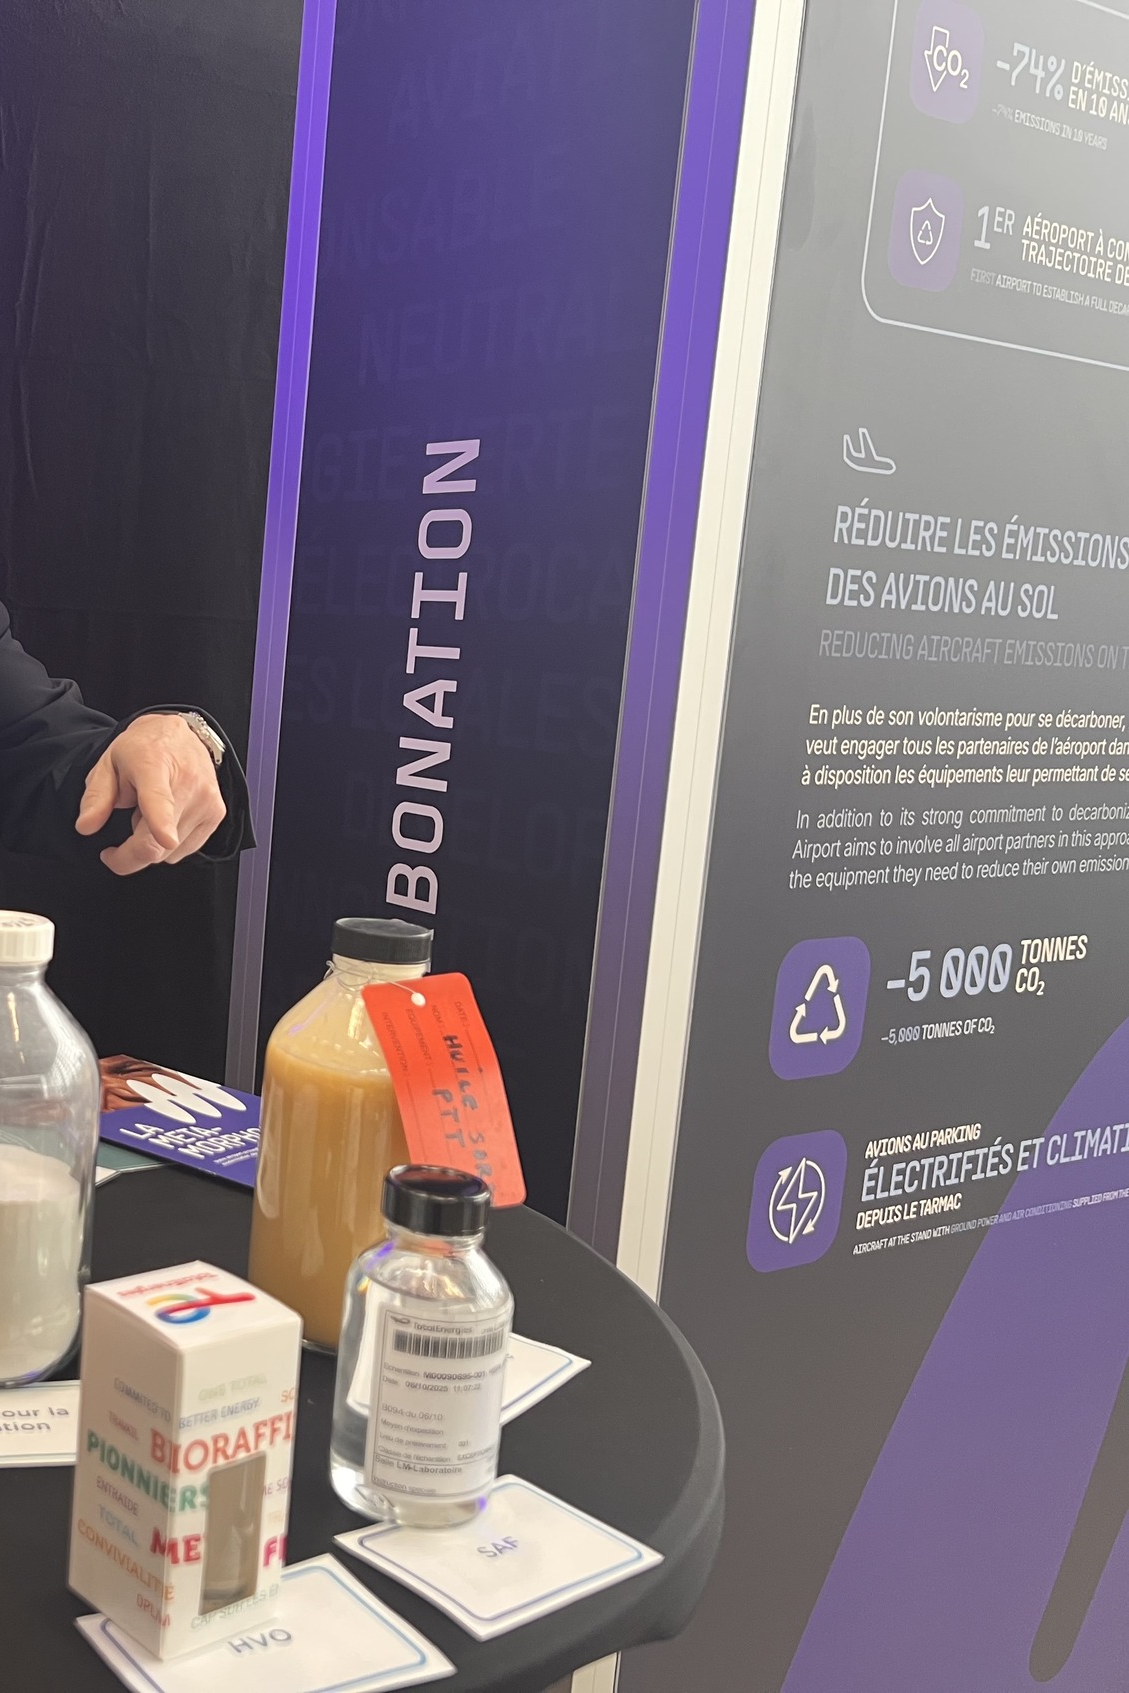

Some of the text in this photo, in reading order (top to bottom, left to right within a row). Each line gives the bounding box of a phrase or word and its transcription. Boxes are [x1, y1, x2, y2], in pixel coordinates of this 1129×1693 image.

[995, 41, 1066, 101] -74%
[1068, 85, 1129, 125] EN 10 AN
[1014, 109, 1061, 136] EMISSIONS
[1061, 123, 1072, 139] IN
[1083, 132, 1108, 151] YEARS
[1022, 212, 1104, 256] AÉROPORT À
[1021, 239, 1114, 282] TRAJECTOIRE
[971, 267, 1108, 312] FIRST AIRPORT TO ESTABLISH A FULL
[833, 497, 1129, 570] RÉDUIRE LES ÉMISSIONS
[825, 567, 1059, 620] DES AVIONS AU SOL
[819, 629, 1118, 670] REDUCING AIRCRAFT EMISSIONS ON
[385, 438, 481, 916] BONATION
[809, 704, 1126, 732] En plus de son volontarisme pour se décarboner,
[806, 736, 838, 755] veut
[840, 740, 900, 760] engager
[903, 737, 932, 755] tous
[935, 736, 955, 755] les
[957, 737, 1029, 759] partenaires
[1032, 736, 1048, 755] de
[1050, 736, 1106, 759] l'aéroport
[801, 764, 1117, 789] à disposition les équipements leur permettant de
[796, 810, 809, 829] In
[816, 809, 872, 829] addition
[880, 810, 893, 827] to
[899, 807, 915, 826] its
[922, 808, 964, 829] strong
[970, 805, 1046, 824] commitment
[1051, 804, 1064, 821] to
[792, 840, 841, 863] Airport
[844, 838, 876, 856] aims
[880, 838, 893, 855] to
[896, 835, 943, 855] involve
[945, 834, 960, 853] all
[962, 833, 1003, 855] airport
[1005, 831, 1055, 855] partners
[1058, 830, 1069, 848] in
[1071, 829, 1092, 847] this
[789, 870, 812, 889] the
[815, 866, 890, 891] equipment
[892, 864, 922, 887] they
[924, 862, 958, 882] need
[961, 862, 973, 880] to
[976, 859, 1020, 879] reduce
[1022, 857, 1049, 876] their
[1051, 859, 1077, 875] own
[1021, 934, 1088, 965] TONNES
[939, 943, 1013, 998] 000
[921, 1019, 963, 1040] TONNES
[963, 1018, 978, 1035] OF
[443, 1034, 478, 1111] HUILE
[120, 1123, 164, 1140] LA
[432, 1088, 465, 1148] PTT
[864, 1122, 982, 1159] AVIONS AU PARKING
[861, 1136, 1014, 1202] ÉLECTRIFIÉS
[1017, 1137, 1045, 1172] ET
[852, 1238, 889, 1255] AIRCRAFT
[887, 1236, 898, 1248] AT
[897, 1233, 911, 1246] THE
[910, 1229, 932, 1243] STAND
[932, 1225, 951, 1238] WITH
[950, 1219, 977, 1234] GROUND
[977, 1214, 999, 1228] POWER
[998, 1212, 1012, 1224] AND
[1012, 1209, 1025, 1220] AIR
[1024, 1199, 1073, 1218] CONDITIONING
[1072, 1193, 1103, 1208] SUPPLIED
[1102, 1189, 1119, 1202] FROM
[856, 1192, 963, 1230] DEPUIS LE TARMAC
[48, 1406, 70, 1417] la
[178, 1397, 260, 1430] BETTER ENERGY
[96, 1475, 139, 1517] ENTRAIDE
[77, 1519, 175, 1601] CONVIVIALITE
[150, 1526, 205, 1565] ME
[476, 1535, 520, 1559] SAF
[227, 1628, 292, 1654] HVO
